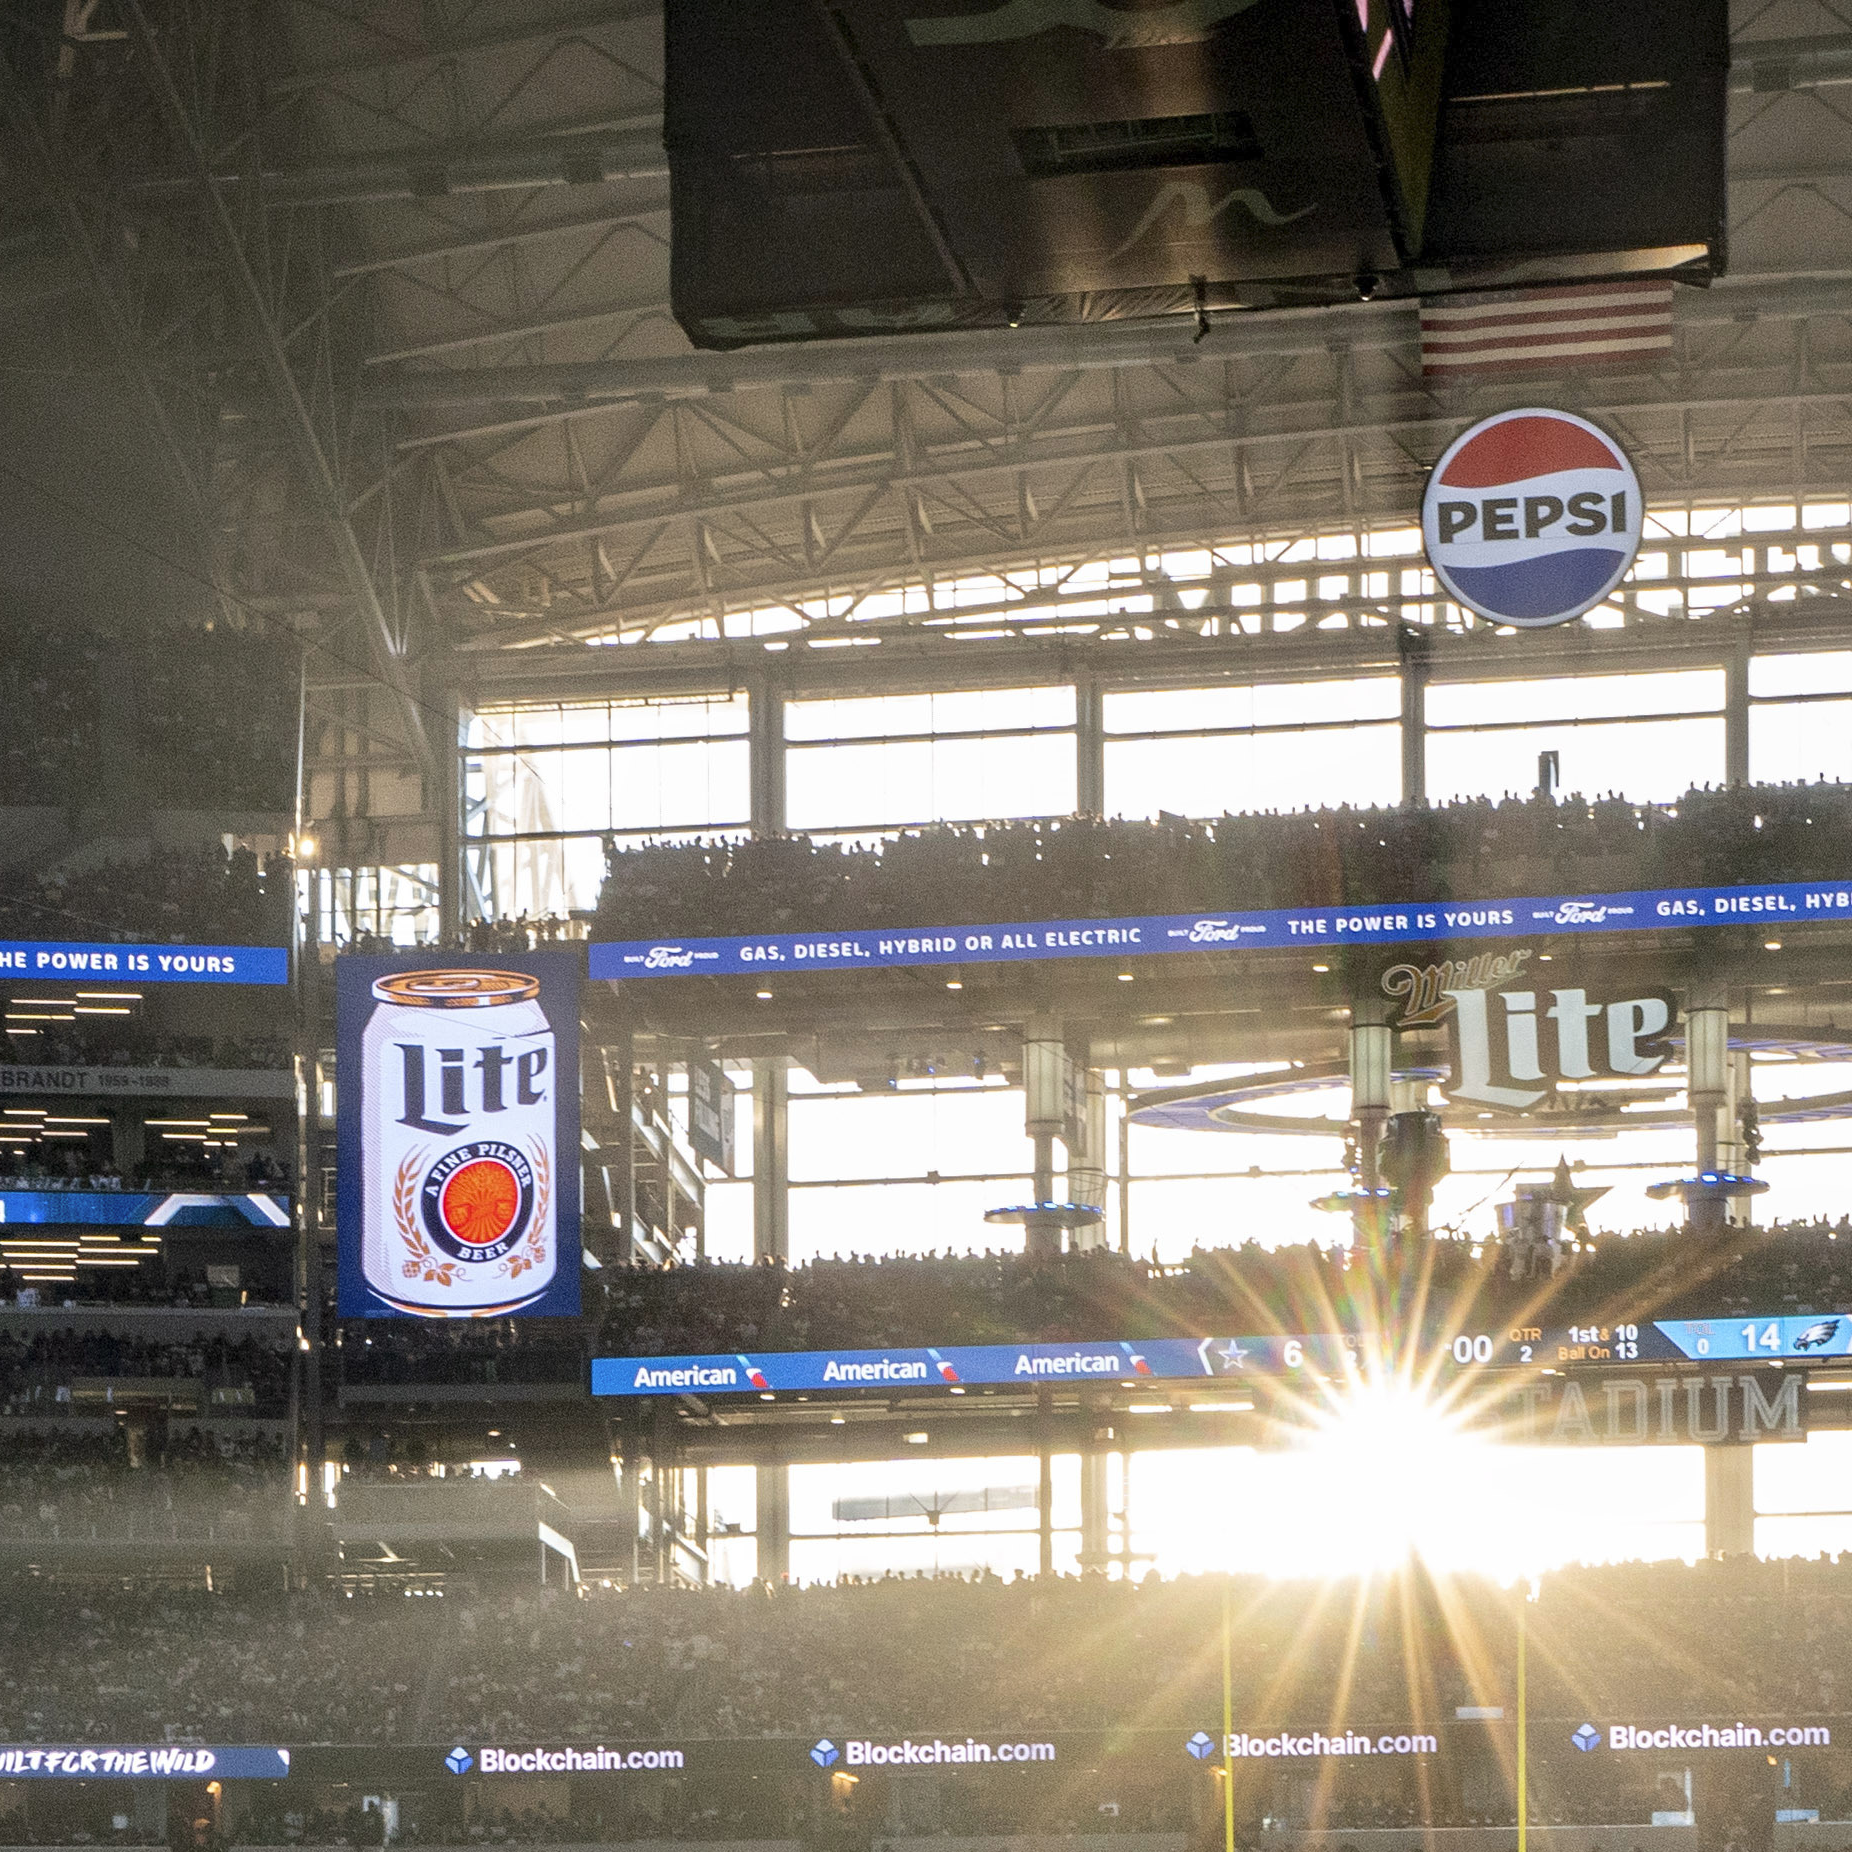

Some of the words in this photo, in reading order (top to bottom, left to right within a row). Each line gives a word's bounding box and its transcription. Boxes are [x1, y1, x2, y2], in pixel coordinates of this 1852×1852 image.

[1438, 489, 1626, 545] PEPSI
[1554, 902, 1607, 924] Ford
[1656, 899, 1705, 916] GAS,
[1714, 895, 1796, 913] DIESEL,
[1188, 920, 1240, 943] Ford
[1287, 919, 1327, 935] THE
[1335, 915, 1408, 933] POWER
[1417, 913, 1437, 929] IS
[1444, 909, 1514, 927] YOURS
[739, 945, 786, 962] GAS,
[794, 941, 870, 959] DIESEL,
[879, 937, 957, 955] HYBRID
[965, 935, 993, 951] OR
[1001, 933, 1038, 949] ALL
[1045, 927, 1141, 947] ELECTRIC
[36, 952, 118, 970] POWER
[128, 954, 150, 971] IS
[158, 955, 235, 973] YOURS
[644, 946, 694, 969] Ford
[1381, 949, 1532, 1016] Miller
[1442, 988, 1669, 1108] Lite
[1, 1072, 87, 1090] BRANDT
[393, 1043, 547, 1137] Lite
[431, 1144, 474, 1182] FINE
[478, 1143, 533, 1188] PILSNER
[457, 1242, 510, 1261] BEER
[1510, 1327, 1542, 1342] QTR
[1569, 1326, 1599, 1344] 1st
[1615, 1324, 1638, 1343] 10
[1741, 1323, 1782, 1352] 14
[1284, 1339, 1304, 1367] 6
[1519, 1345, 1533, 1363] 2
[1558, 1346, 1586, 1361] Ball
[1590, 1345, 1611, 1360] On
[1619, 1343, 1639, 1360] 13
[1697, 1338, 1710, 1356] 0
[823, 1358, 927, 1382] American
[1014, 1351, 1120, 1375] American
[633, 1364, 737, 1388] American
[1223, 1731, 1437, 1758] Blockchain.com
[1609, 1721, 1830, 1750] Blockchain.com
[480, 1745, 684, 1773] Blockchain.com
[846, 1738, 1055, 1765] Blockchain.com
